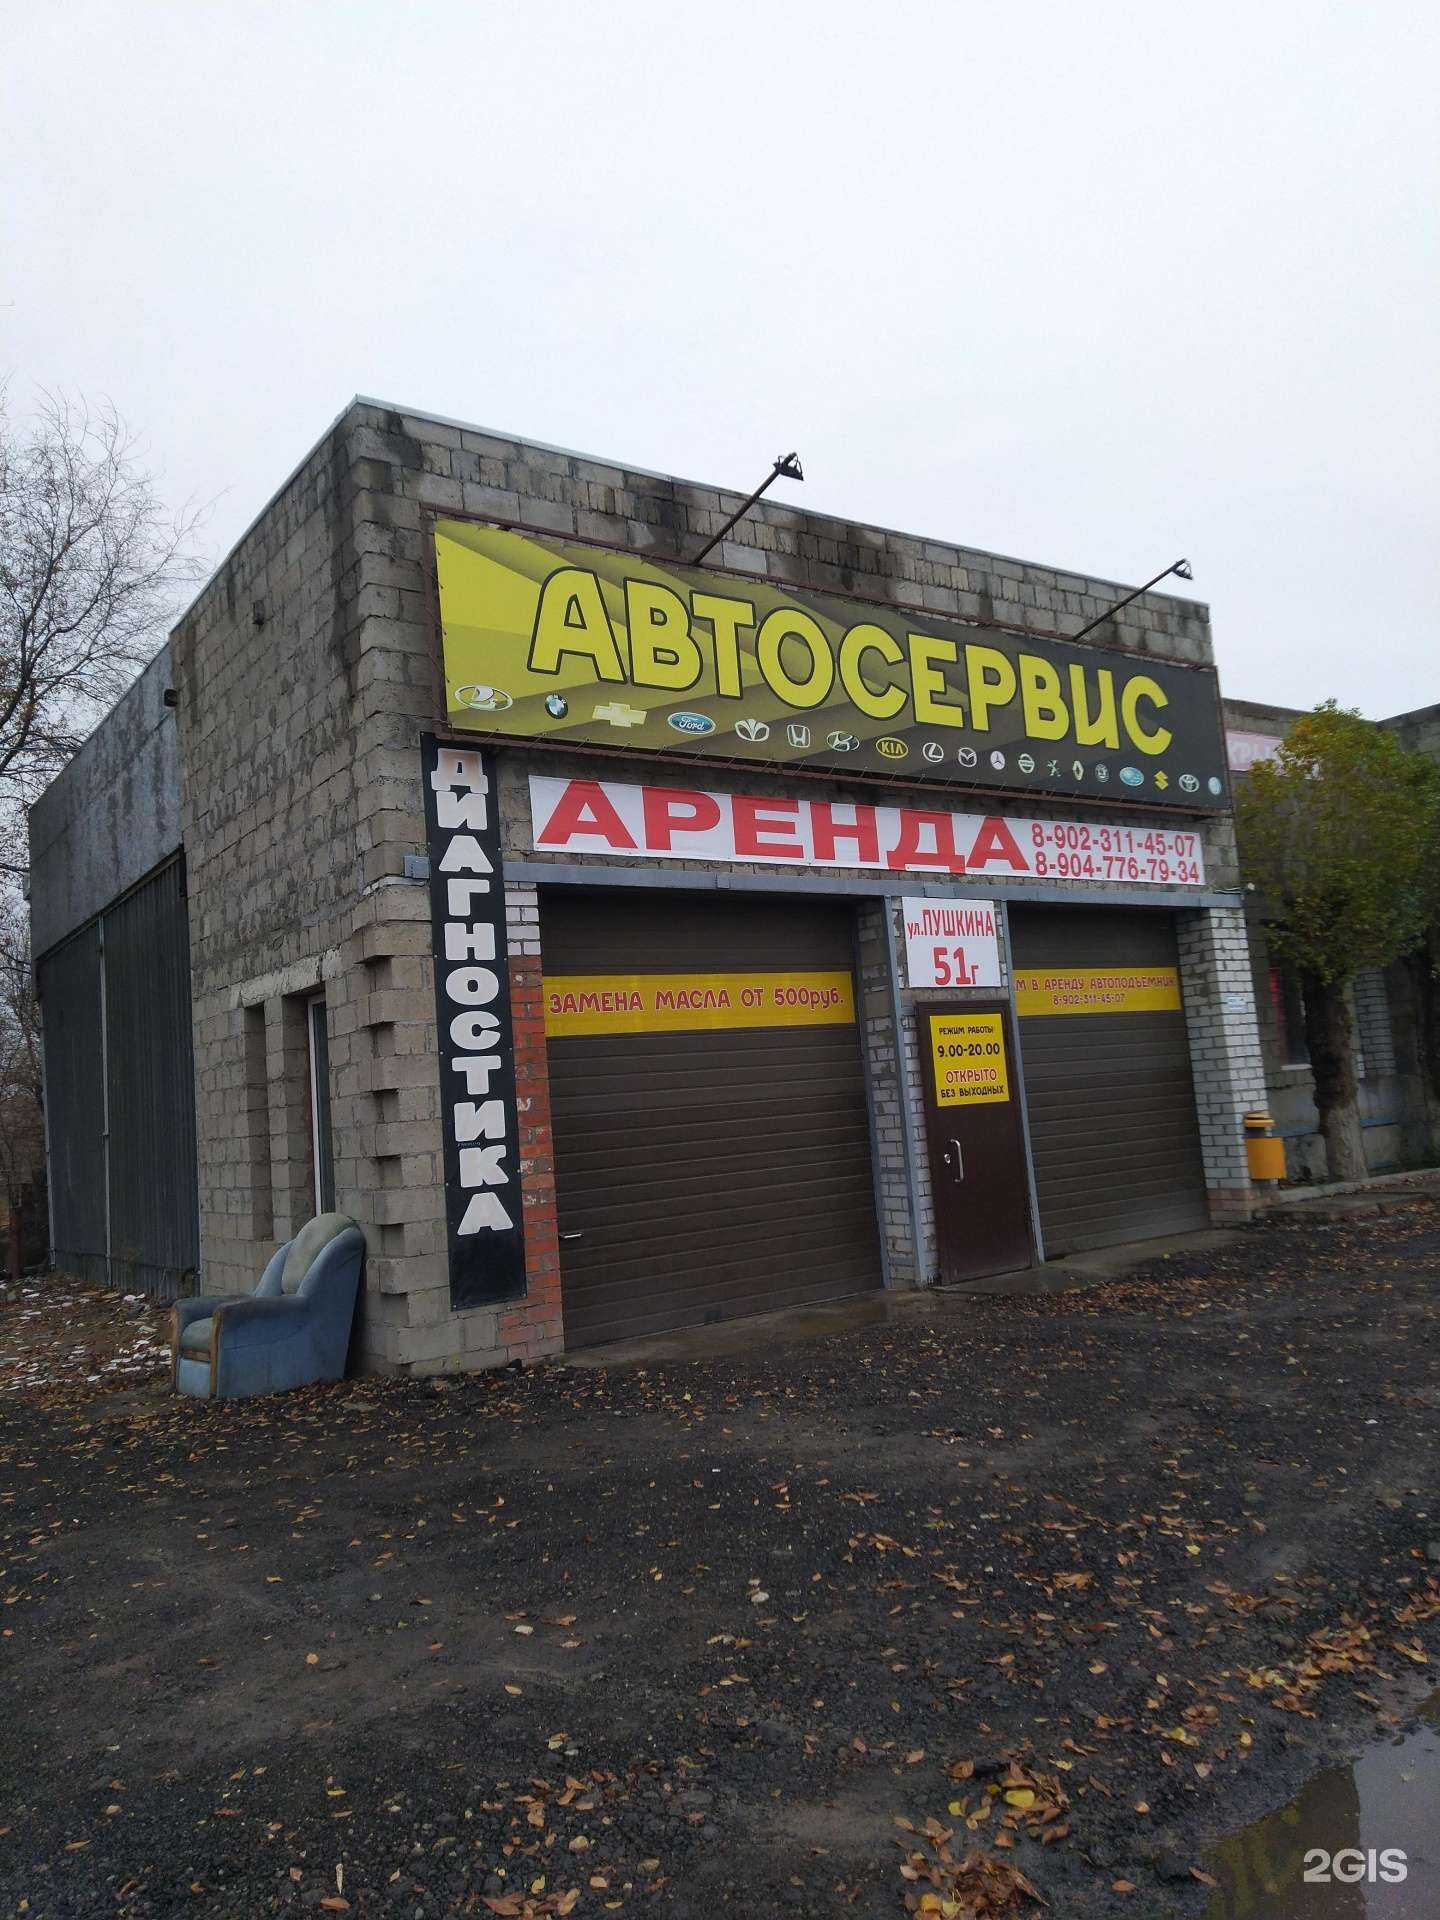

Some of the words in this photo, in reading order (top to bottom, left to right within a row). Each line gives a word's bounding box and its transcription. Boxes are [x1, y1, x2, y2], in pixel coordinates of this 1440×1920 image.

[527, 566, 1174, 755] АВТОСЕРВИС
[679, 715, 705, 731] Ford
[881, 741, 904, 754] KIA
[536, 779, 1030, 875] АРЕНДА
[1031, 822, 1196, 858] 8-902-311-45-07
[1035, 851, 1200, 883] 8-904-776-79-34
[932, 946, 979, 986] 51г
[430, 747, 514, 1236] ДИАГНОСТИКА
[1031, 978, 1039, 991] В
[1044, 977, 1085, 991] АРЕНДУ
[549, 990, 644, 1014] ЗАМЕНА
[655, 987, 732, 1010] МАСЛА
[740, 987, 764, 1008] ОТ
[773, 986, 845, 1010] 500руб.
[938, 1026, 966, 1035] РЕЖИМ
[967, 1025, 995, 1035] РАБОТЫ
[937, 1042, 1000, 1058] 9.00-20.00
[945, 1067, 998, 1084] ОТКРЫТО
[940, 1086, 957, 1098] БЕЗ
[959, 1084, 1005, 1097] ВЫХОДНЫХ
